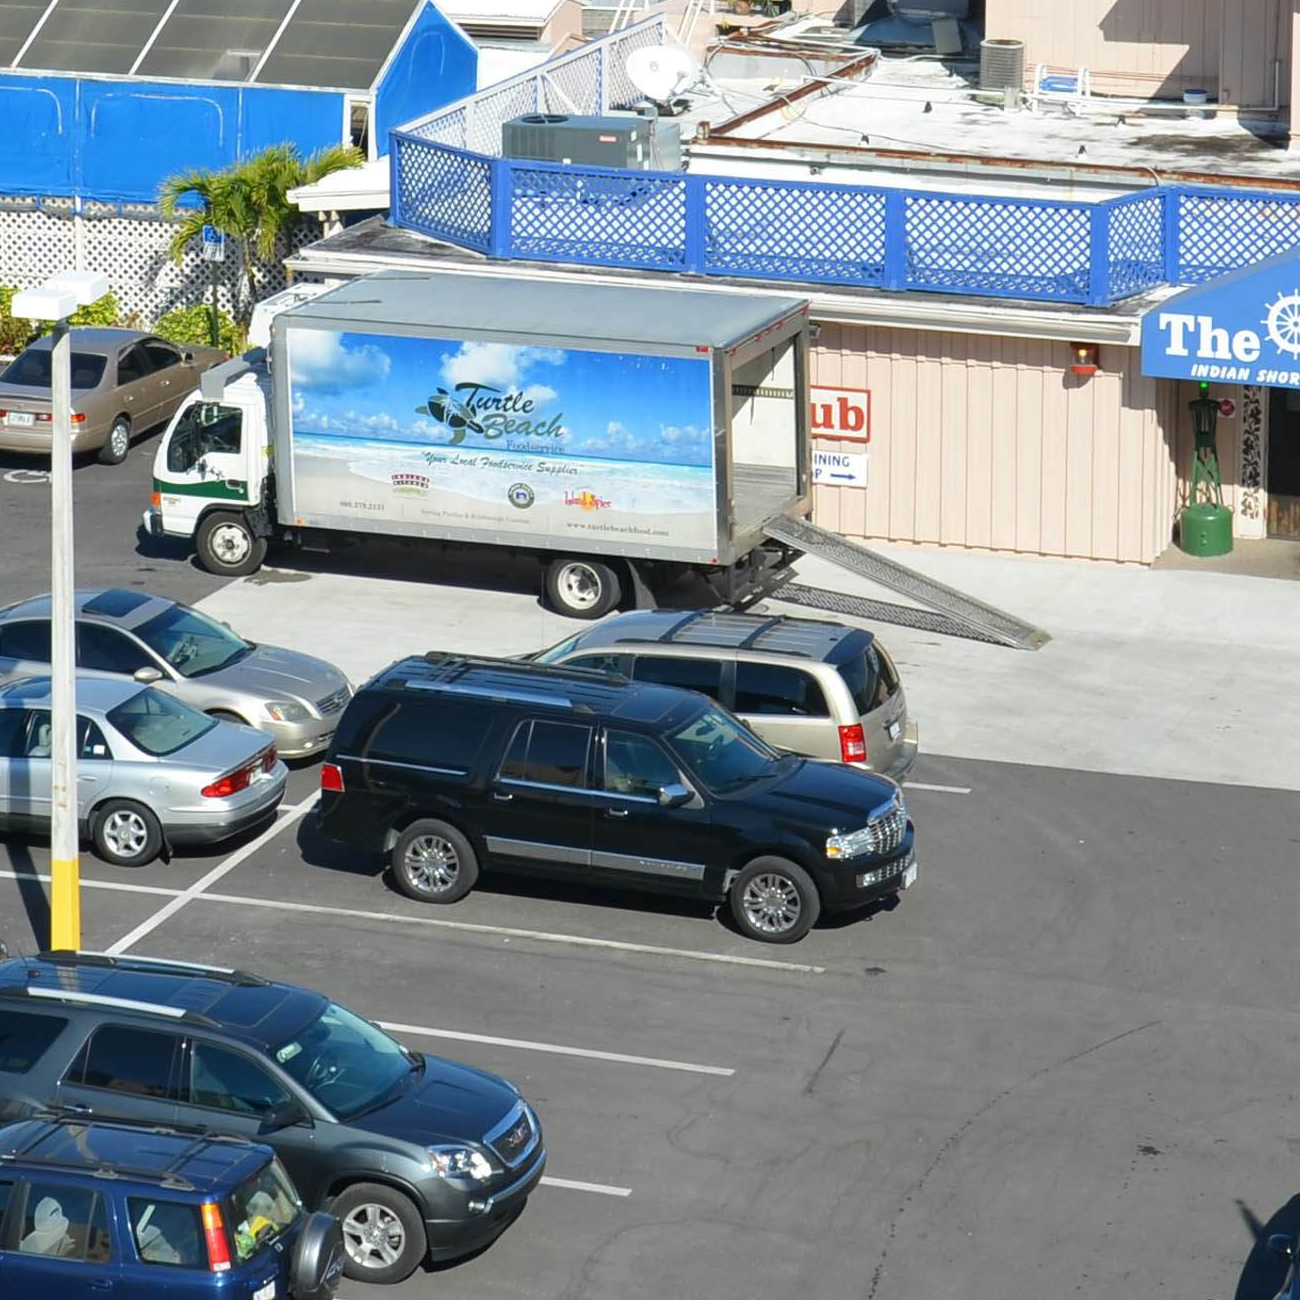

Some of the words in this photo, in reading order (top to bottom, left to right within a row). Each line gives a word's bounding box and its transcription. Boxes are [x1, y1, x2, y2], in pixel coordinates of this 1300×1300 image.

[1159, 313, 1261, 362] The
[1191, 364, 1251, 381] INDIAN
[455, 382, 534, 414] Turtle
[481, 412, 564, 440] Beach
[811, 397, 865, 432] ub
[451, 453, 477, 466] Local
[480, 456, 533, 471] Foodservice
[814, 453, 850, 468] INING
